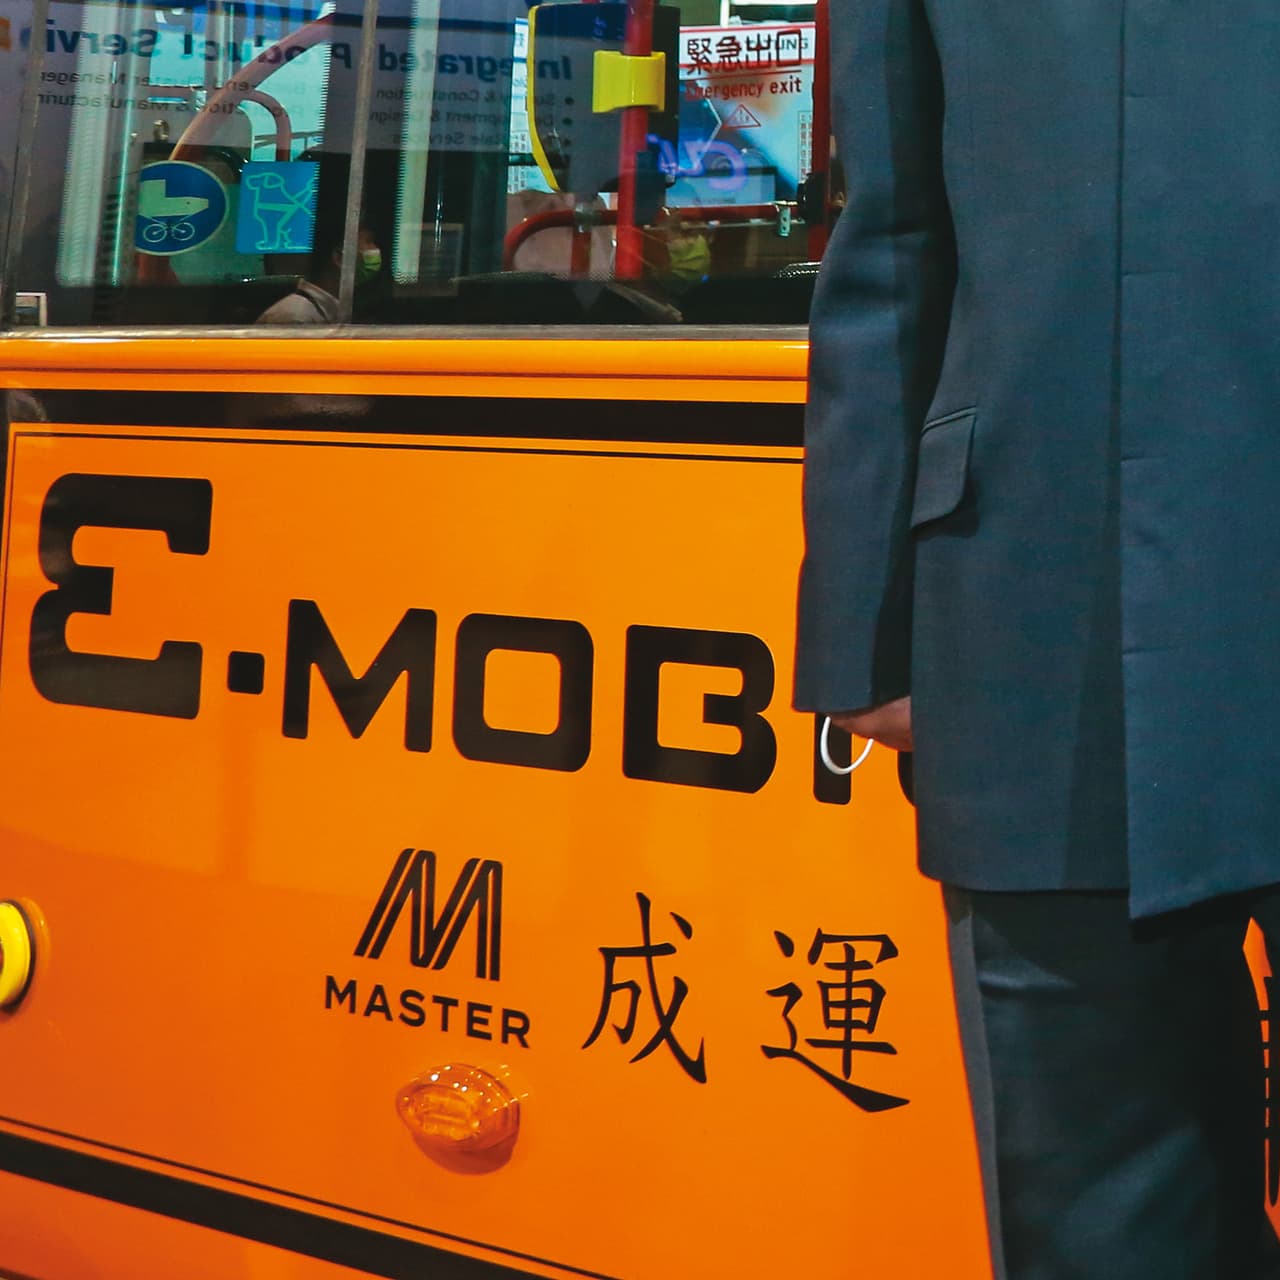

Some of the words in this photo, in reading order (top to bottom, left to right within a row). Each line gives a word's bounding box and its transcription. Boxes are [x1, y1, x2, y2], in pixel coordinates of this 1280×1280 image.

[687, 30, 802, 75] 緊急出口
[769, 76, 802, 94] exit
[325, 975, 532, 1050] MASTER
